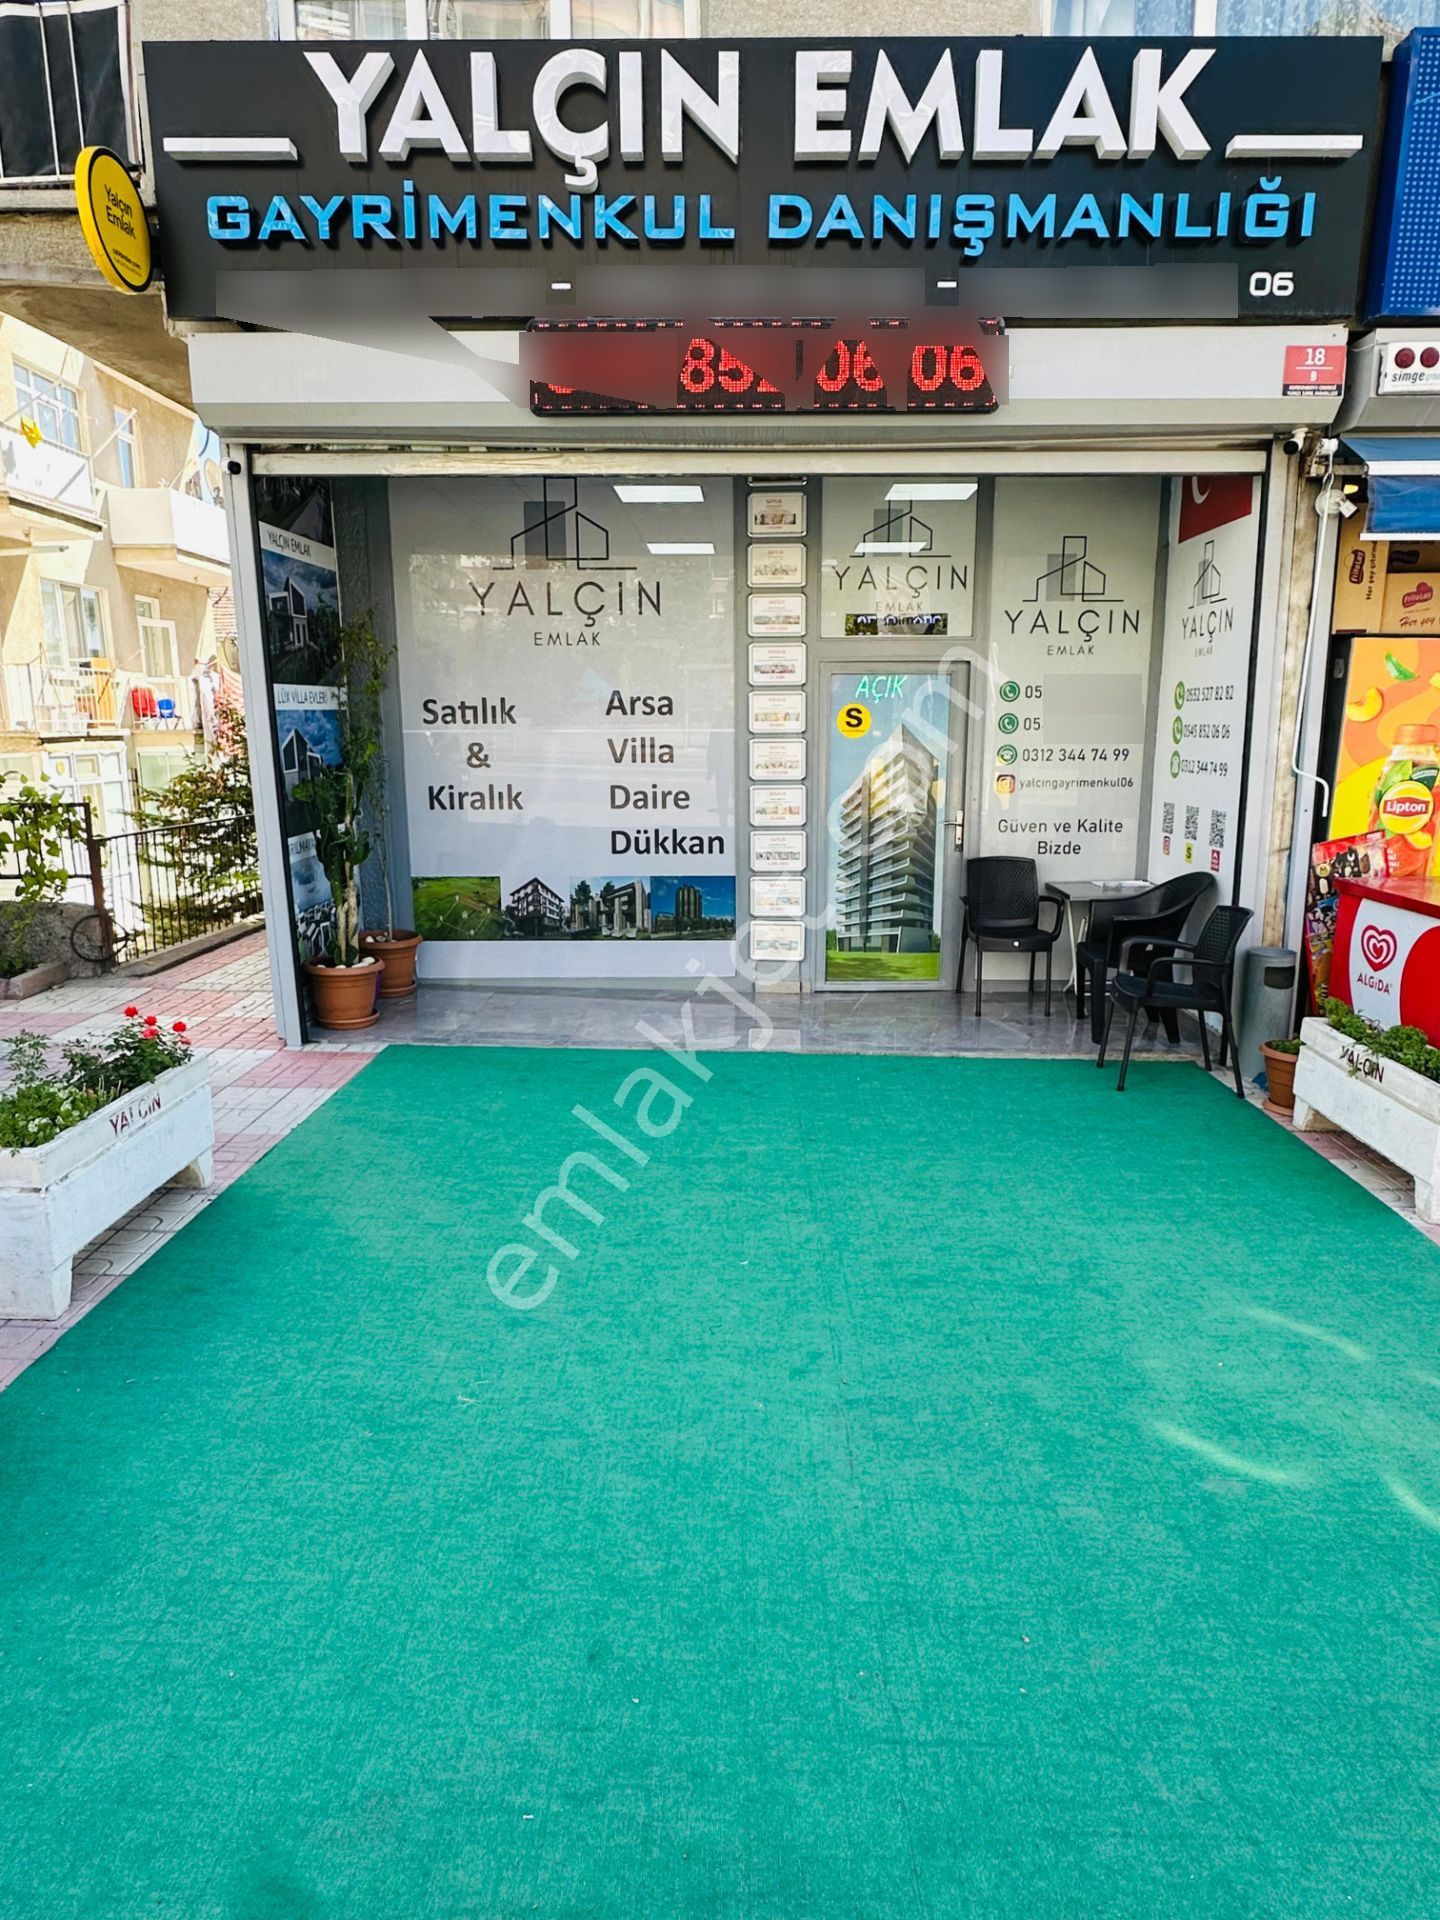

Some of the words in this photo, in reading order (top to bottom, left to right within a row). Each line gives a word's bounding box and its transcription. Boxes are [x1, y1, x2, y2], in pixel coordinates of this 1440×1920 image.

[304, 47, 740, 194] YALÇIN
[793, 46, 1217, 164] EMLAK
[105, 204, 136, 239] Emlak
[207, 180, 735, 242] GAYRİMENKUL
[768, 176, 1317, 257] DANIŞMANLIĞI
[1249, 270, 1295, 297] 06
[679, 337, 786, 393] 85
[909, 344, 987, 392] 06
[1305, 348, 1326, 365] 18
[1391, 371, 1426, 383] simge
[267, 530, 290, 552] YALÇIN
[290, 538, 312, 557] EMLAK
[832, 565, 968, 599] YALÇIN
[469, 580, 662, 627] YALÇIN
[875, 601, 924, 612] EMLAK
[1004, 609, 1140, 643] YALÇIN
[1182, 607, 1234, 643] YALÇIN
[533, 631, 602, 646] EMLAK
[1046, 645, 1095, 656] EMLAK
[1194, 646, 1213, 658] EMLAK
[855, 675, 908, 703] AÇIK
[1214, 686, 1224, 701] 82
[1225, 685, 1234, 700] 82
[422, 697, 517, 725] Satılık
[605, 690, 674, 716] Arsa
[845, 707, 863, 728] S
[1023, 717, 1044, 731] 05
[1211, 724, 1220, 739] 06
[1221, 724, 1231, 739] 06
[466, 742, 491, 769] &
[607, 737, 675, 764] Villa
[1022, 748, 1053, 762] 0312
[1058, 748, 1086, 762] 344
[1091, 748, 1108, 762] 74
[1112, 748, 1130, 762] 99
[1196, 760, 1208, 775] 344
[1209, 761, 1217, 776] 74
[1218, 762, 1228, 777] 99
[427, 783, 524, 811] Kiralık
[609, 784, 691, 810] Daire
[1386, 801, 1426, 814] Lipton
[998, 818, 1048, 833] Güven
[1054, 822, 1072, 833] ve
[1077, 818, 1124, 833] Kalite
[610, 829, 725, 855] Dükkan
[1037, 840, 1082, 855] Bizde
